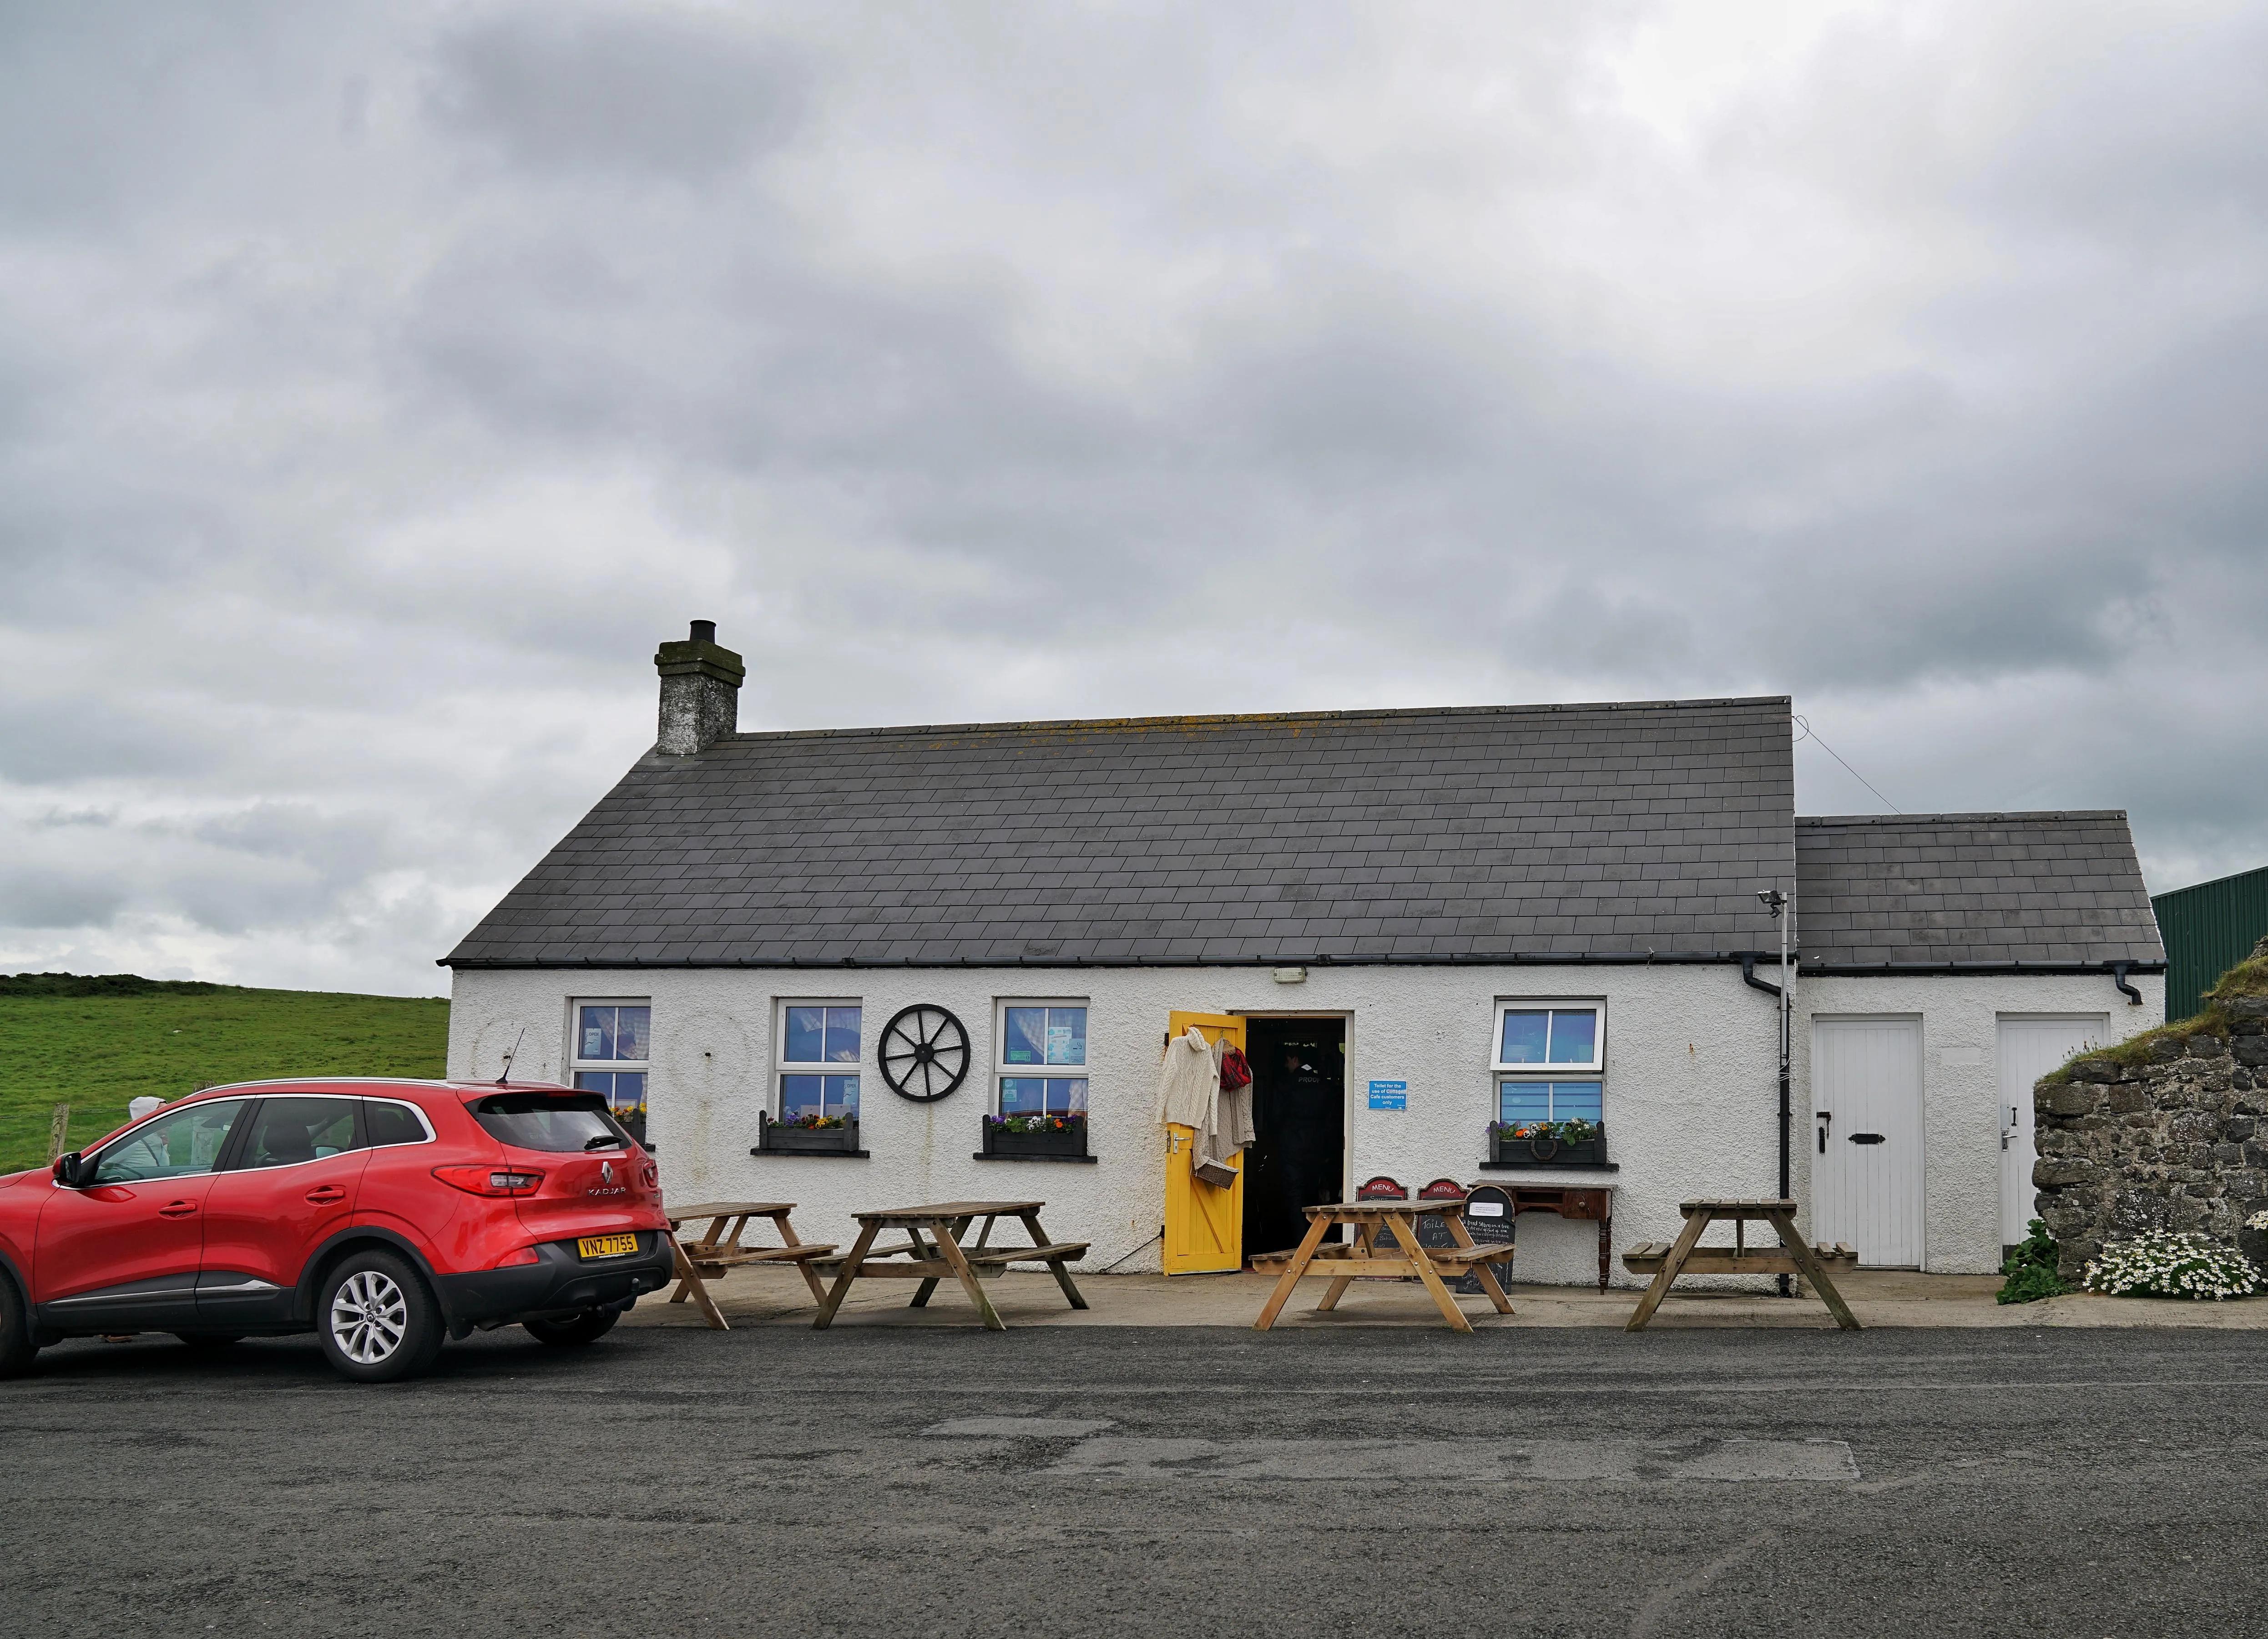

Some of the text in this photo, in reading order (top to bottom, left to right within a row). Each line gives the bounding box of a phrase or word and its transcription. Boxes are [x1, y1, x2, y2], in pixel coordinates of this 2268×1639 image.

[588, 1187, 626, 1196] KADJAR
[1432, 1231, 1447, 1240] AT
[582, 1236, 633, 1255] VNZ 7755
